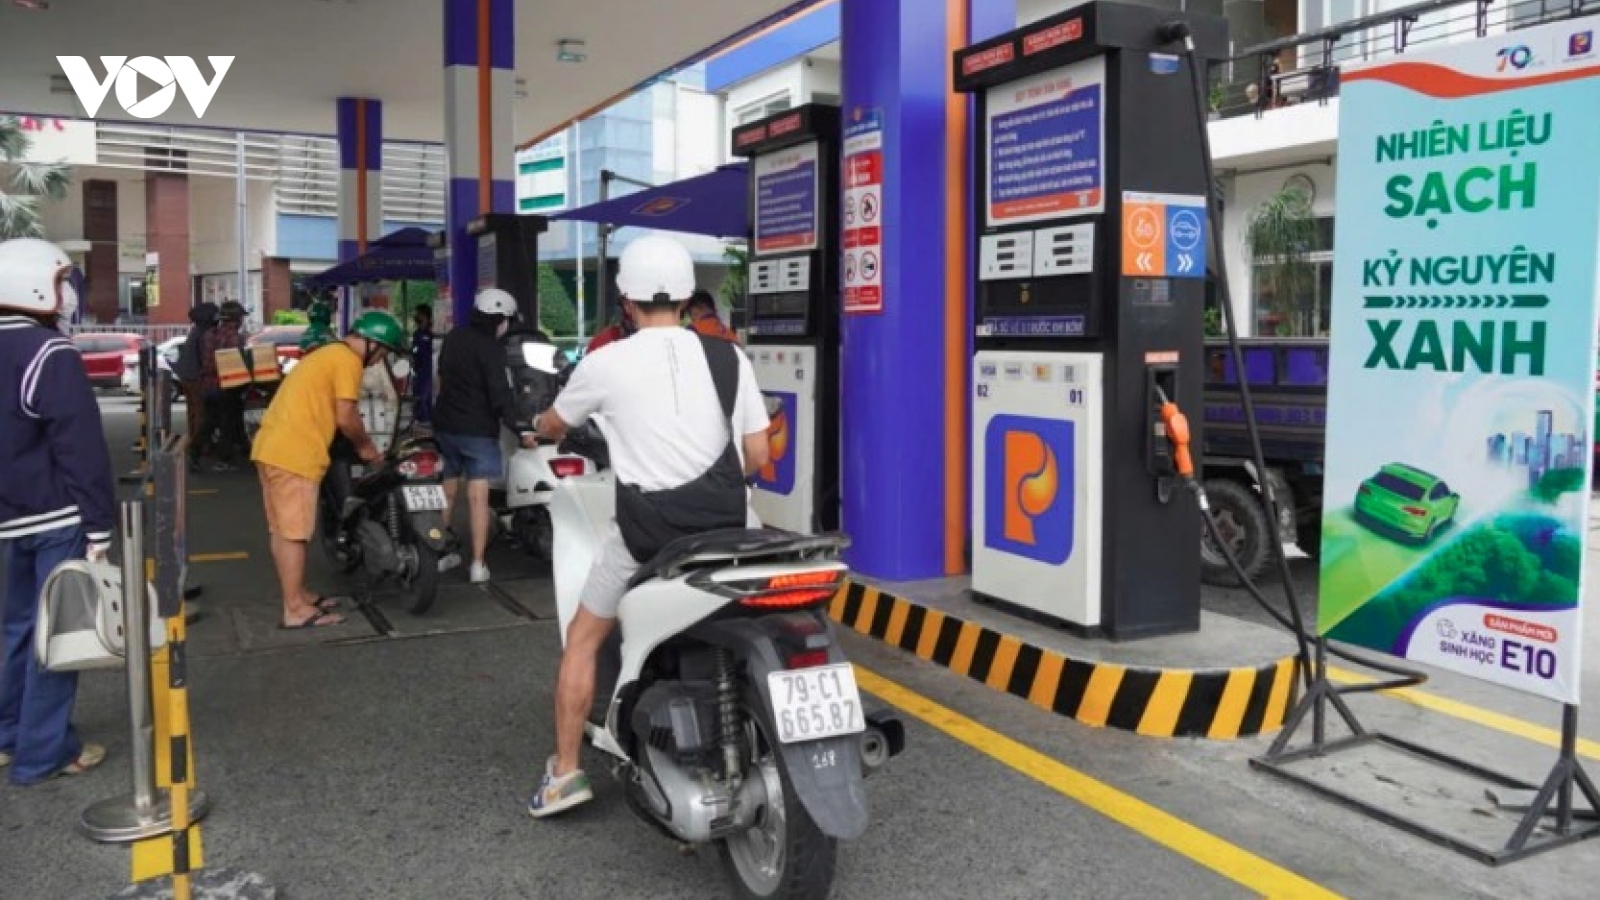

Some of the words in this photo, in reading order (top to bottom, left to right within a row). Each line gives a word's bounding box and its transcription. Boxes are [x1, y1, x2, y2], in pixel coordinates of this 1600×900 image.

[1376, 119, 1470, 163] NHIÊN
[1478, 108, 1553, 158] LIỆU
[1383, 162, 1537, 230] SẠCH
[1363, 249, 1403, 287] KỶ
[1409, 245, 1555, 287] NGUYÊN
[1363, 319, 1547, 376] XANH
[1069, 388, 1083, 404] 01
[1440, 640, 1468, 657] SINH
[1469, 648, 1495, 665] HỌC
[1461, 630, 1495, 649] XĂNG
[1501, 638, 1557, 680] E10
[781, 670, 842, 705] 79-C1
[781, 699, 855, 739] 665.87
